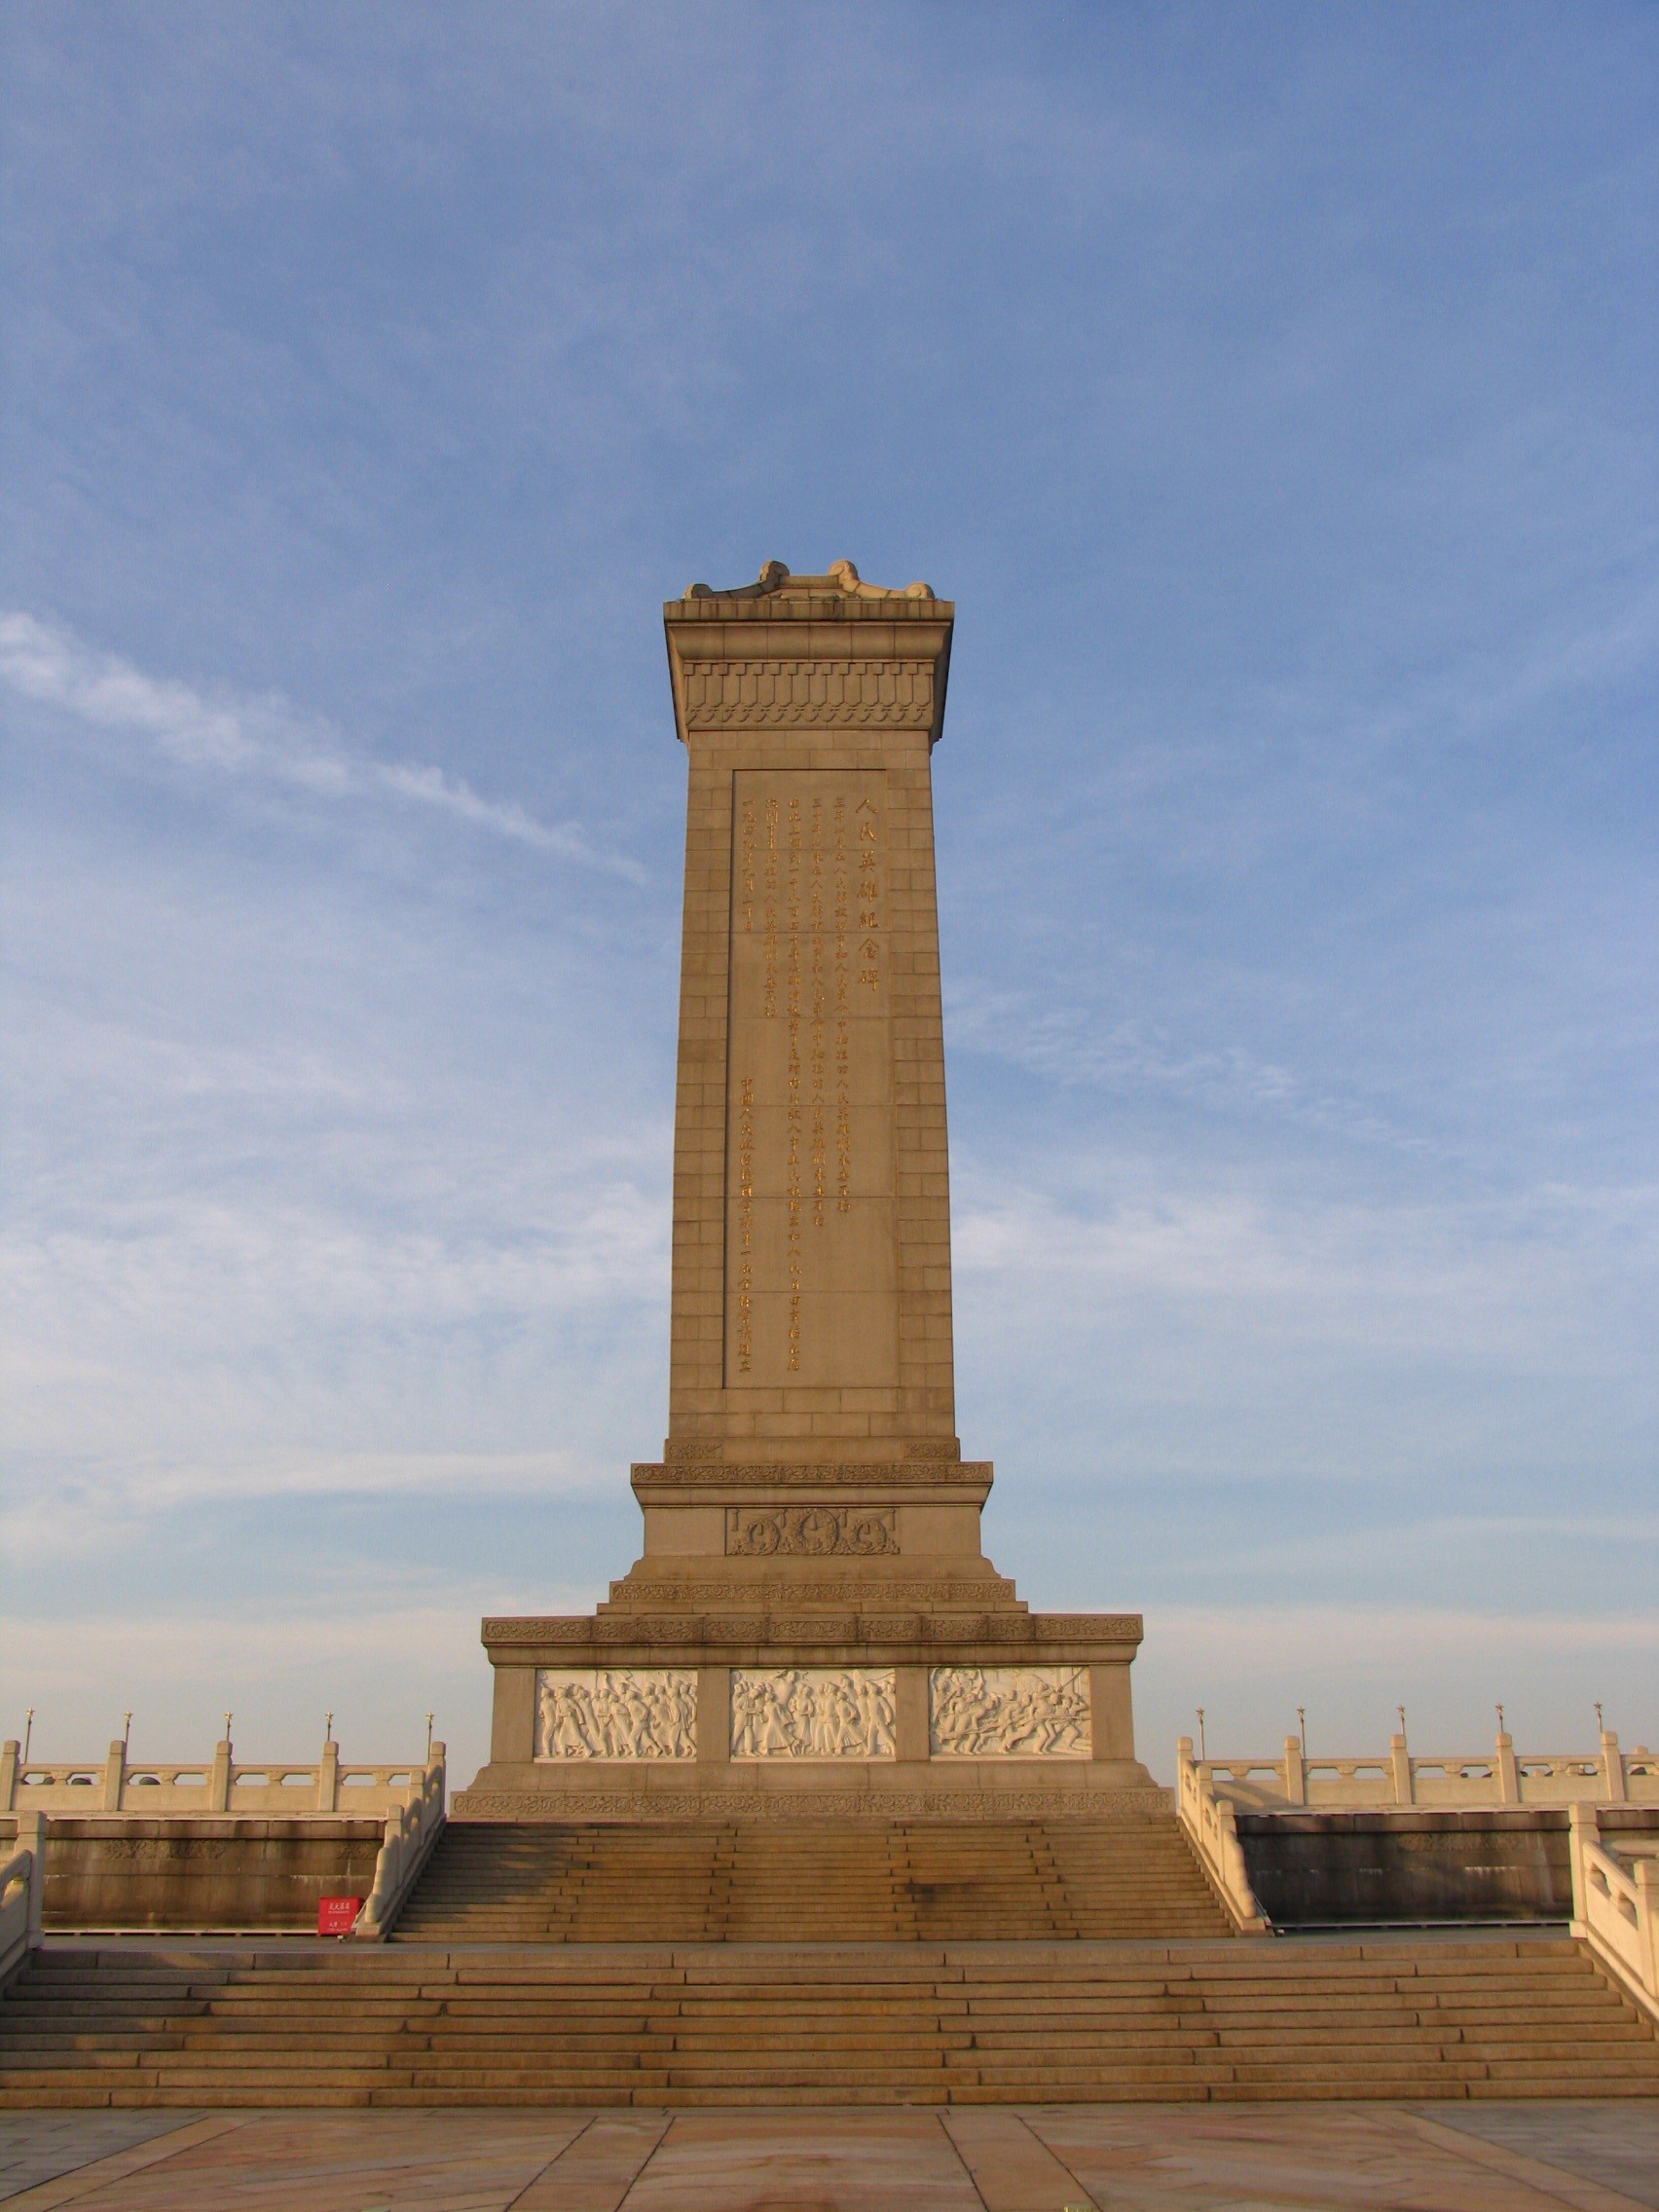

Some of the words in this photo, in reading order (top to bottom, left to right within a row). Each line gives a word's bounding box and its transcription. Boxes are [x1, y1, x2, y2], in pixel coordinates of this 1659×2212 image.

[856, 798, 880, 990] 人民英雄紀念碑
